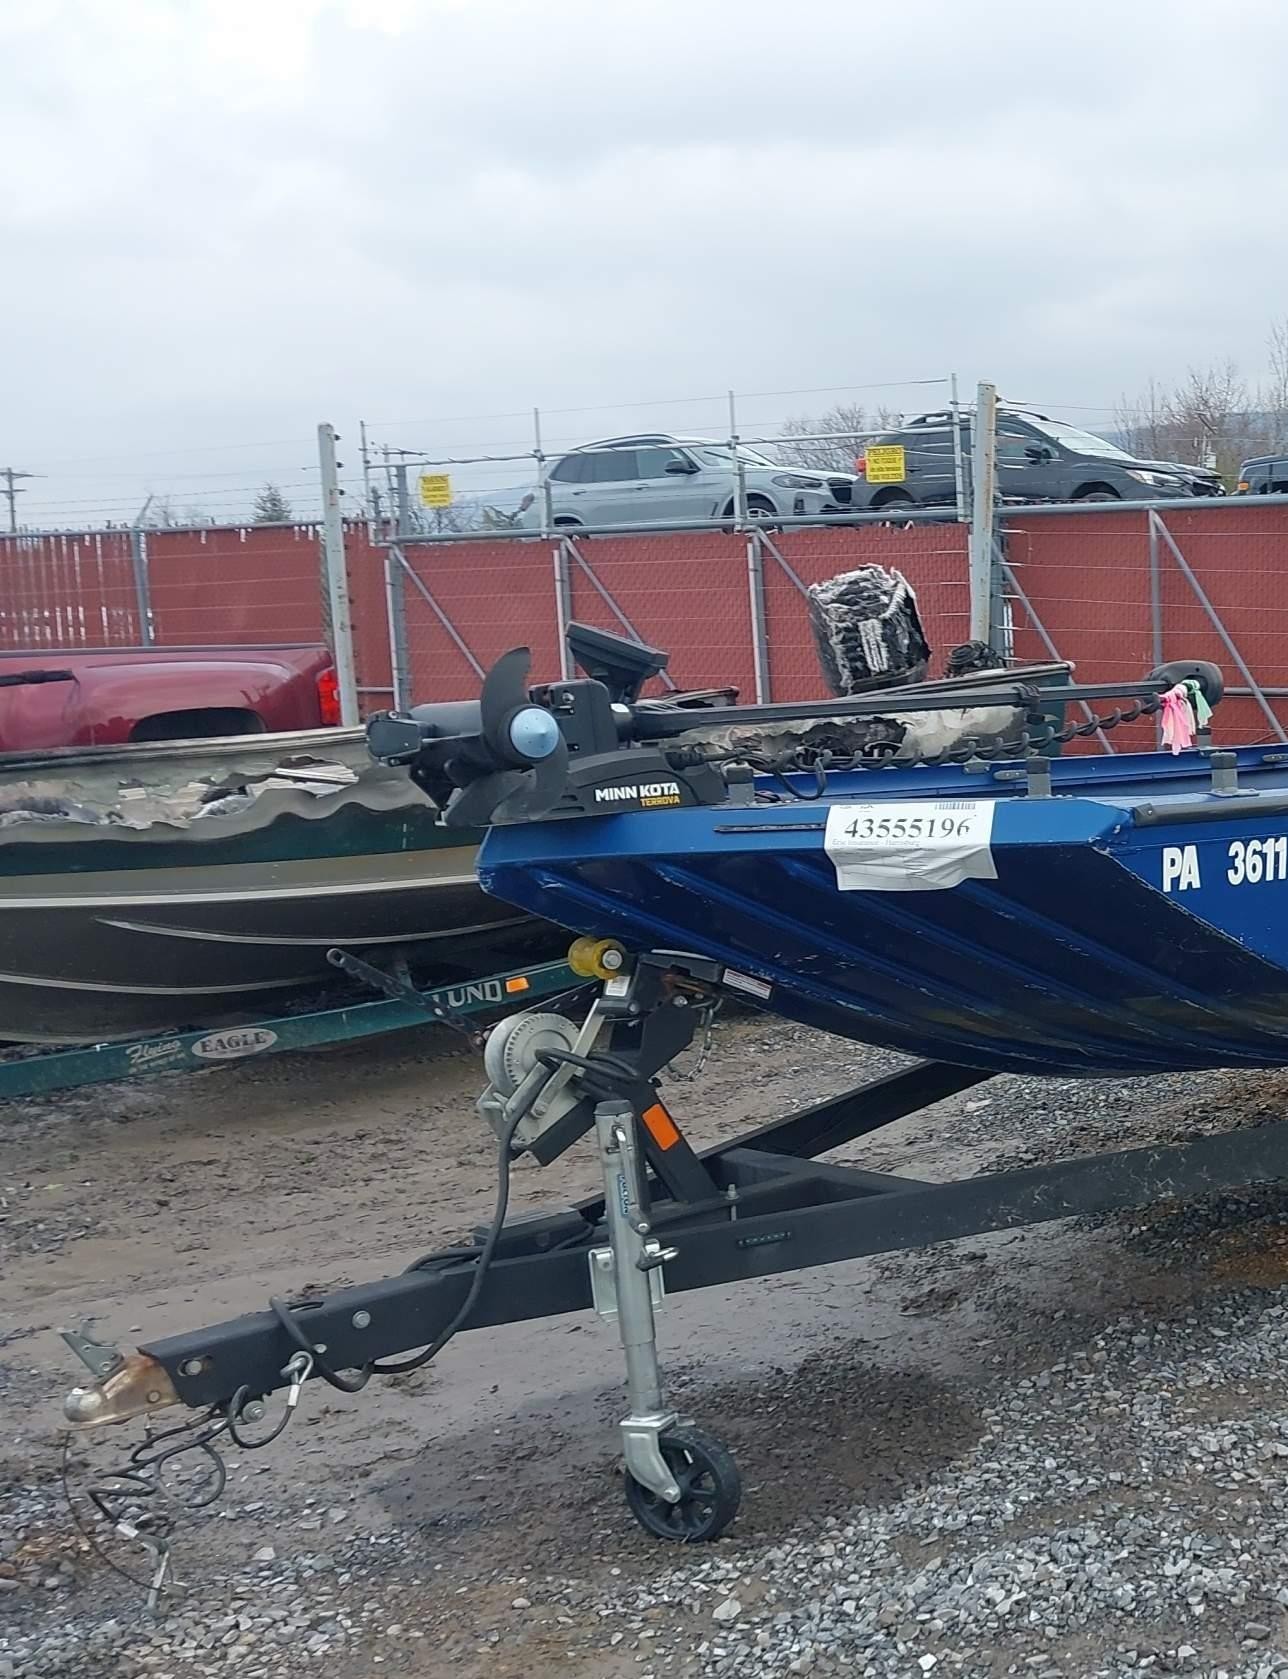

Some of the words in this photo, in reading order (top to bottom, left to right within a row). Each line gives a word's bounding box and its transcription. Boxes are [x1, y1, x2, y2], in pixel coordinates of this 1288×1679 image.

[595, 785, 638, 802] MINN
[640, 782, 680, 797] KOTA
[640, 796, 680, 807] TERROVA
[844, 817, 971, 839] 43555196
[1163, 845, 1200, 892] PA
[1227, 836, 1288, 885] 3611
[200, 1031, 267, 1053] EAGLE
